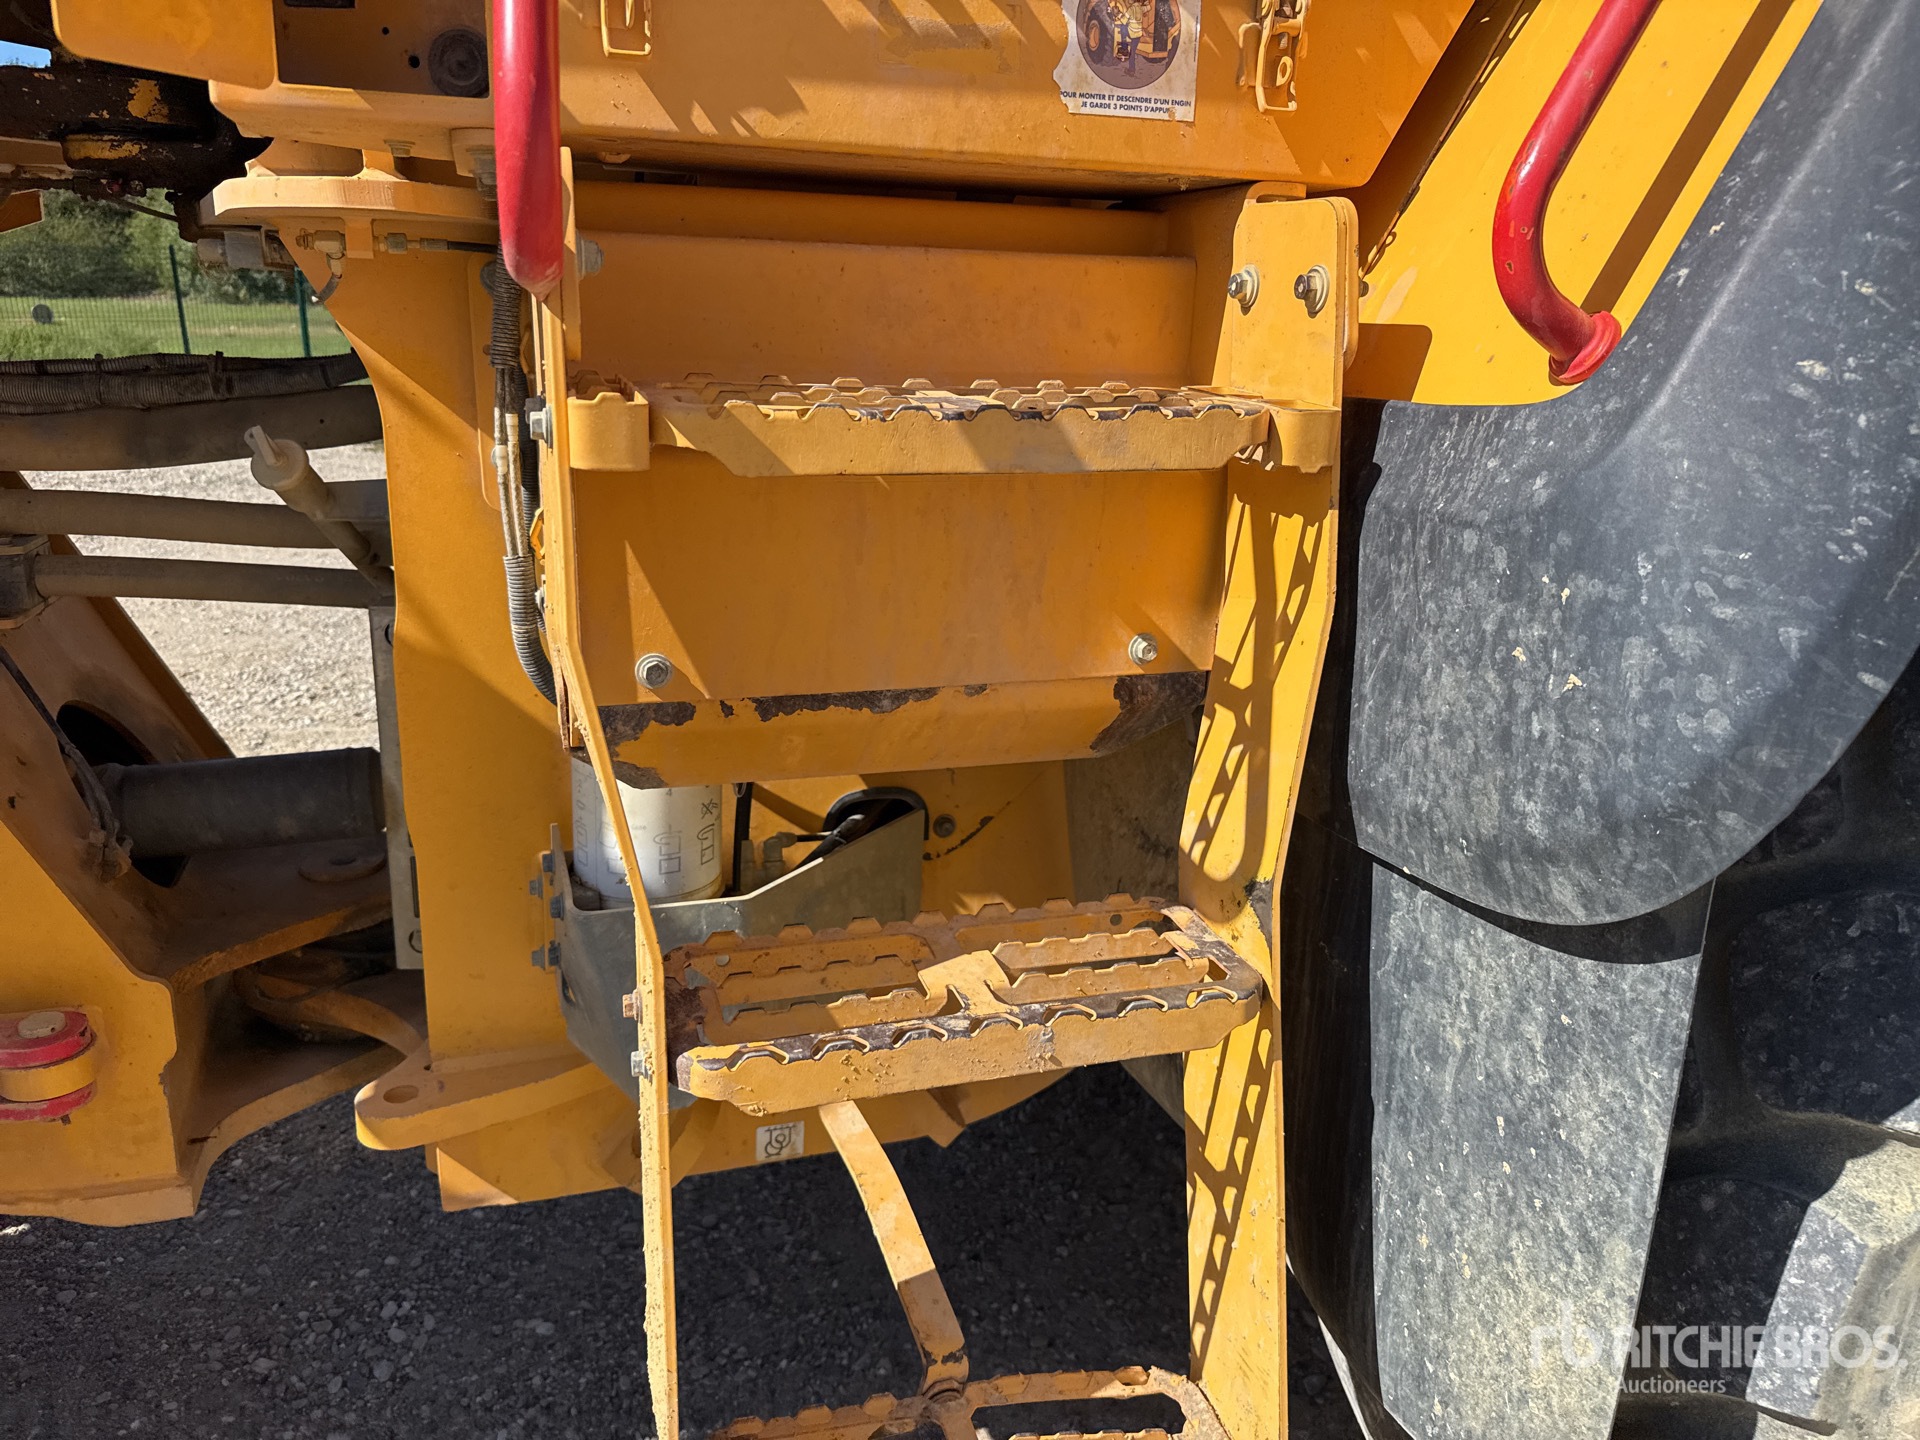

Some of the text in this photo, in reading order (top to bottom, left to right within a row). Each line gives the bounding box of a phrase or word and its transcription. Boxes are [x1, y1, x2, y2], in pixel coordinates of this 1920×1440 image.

[1079, 92, 1106, 101] MONTER
[1108, 94, 1115, 102] ET
[1116, 95, 1152, 104] DESCENDRE
[1154, 97, 1170, 105] D'UN
[1171, 99, 1192, 107] ENGIN
[1119, 104, 1143, 112] POINTS
